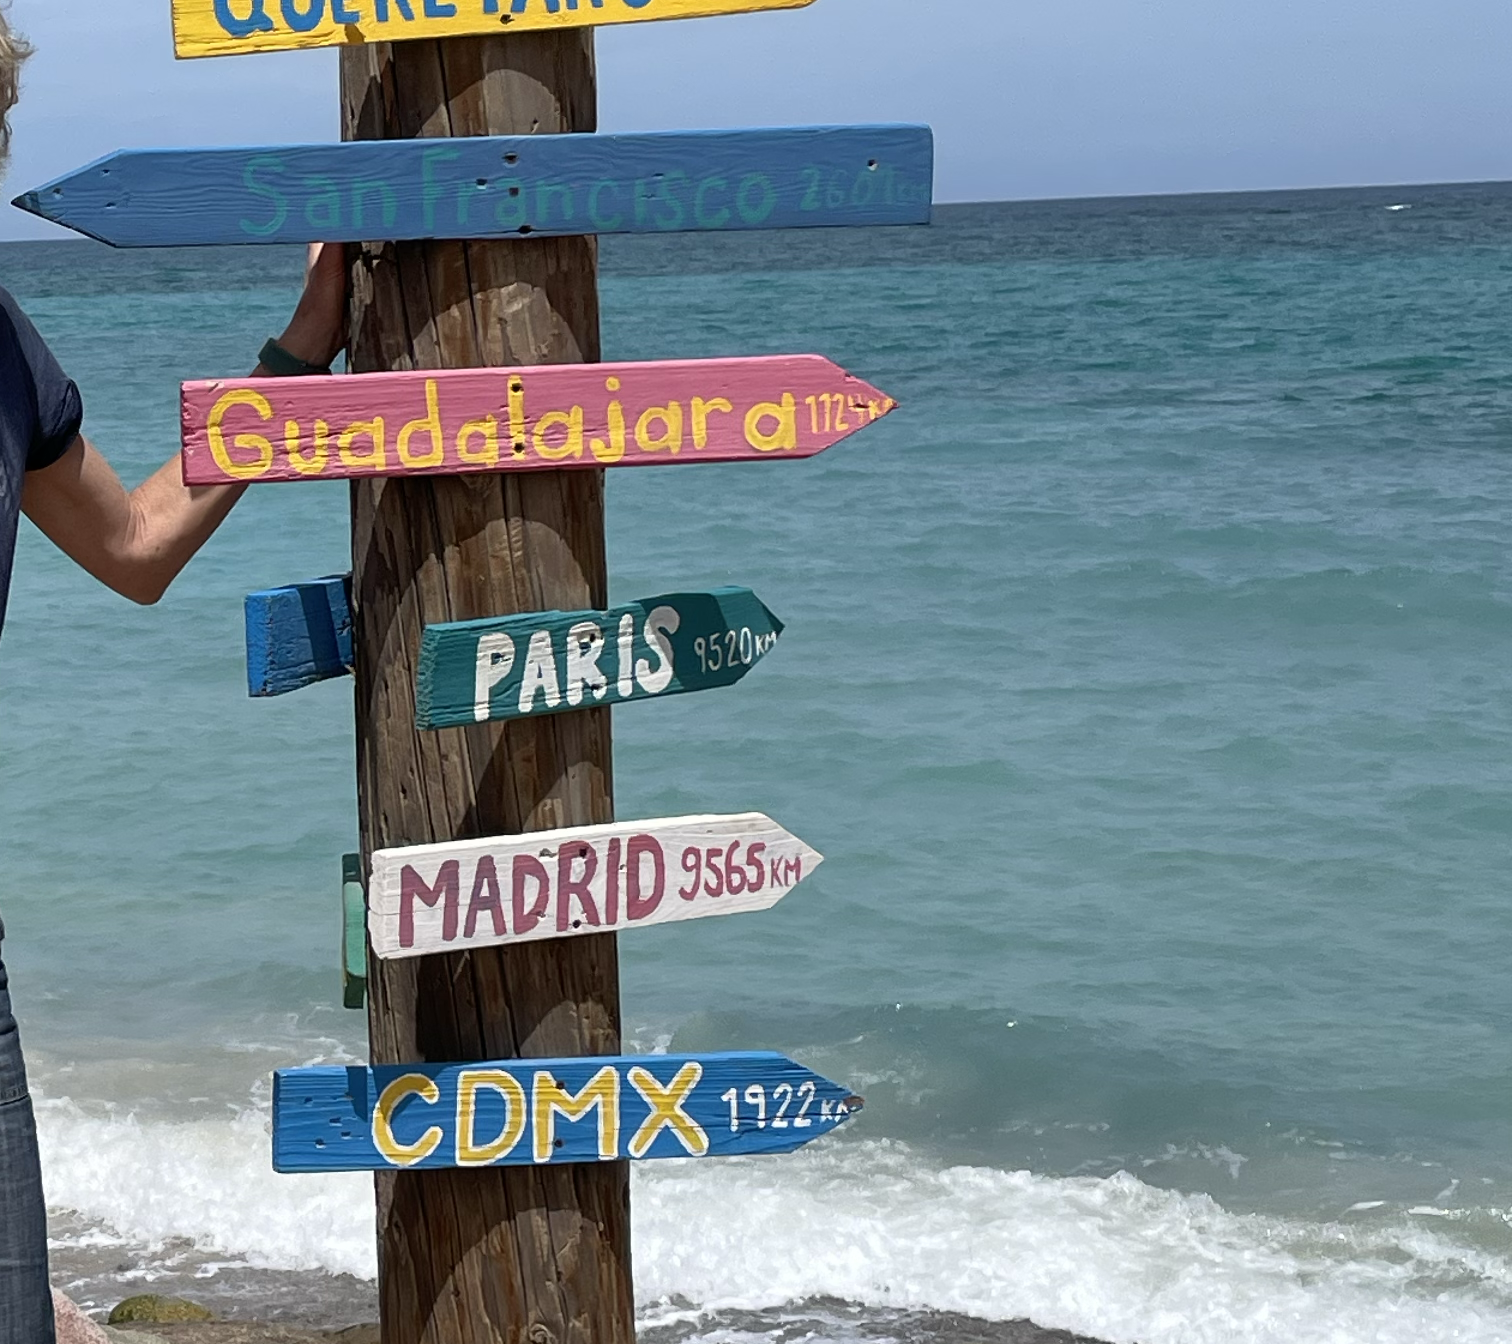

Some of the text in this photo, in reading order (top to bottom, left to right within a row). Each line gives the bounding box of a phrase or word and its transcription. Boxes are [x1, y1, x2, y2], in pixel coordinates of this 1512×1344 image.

[239, 156, 397, 236] San
[422, 149, 780, 229] Francisco
[206, 376, 796, 479] Guadalajara
[473, 605, 681, 722] PARIS
[398, 834, 667, 948] MADRID
[371, 1061, 708, 1167] CDMX
